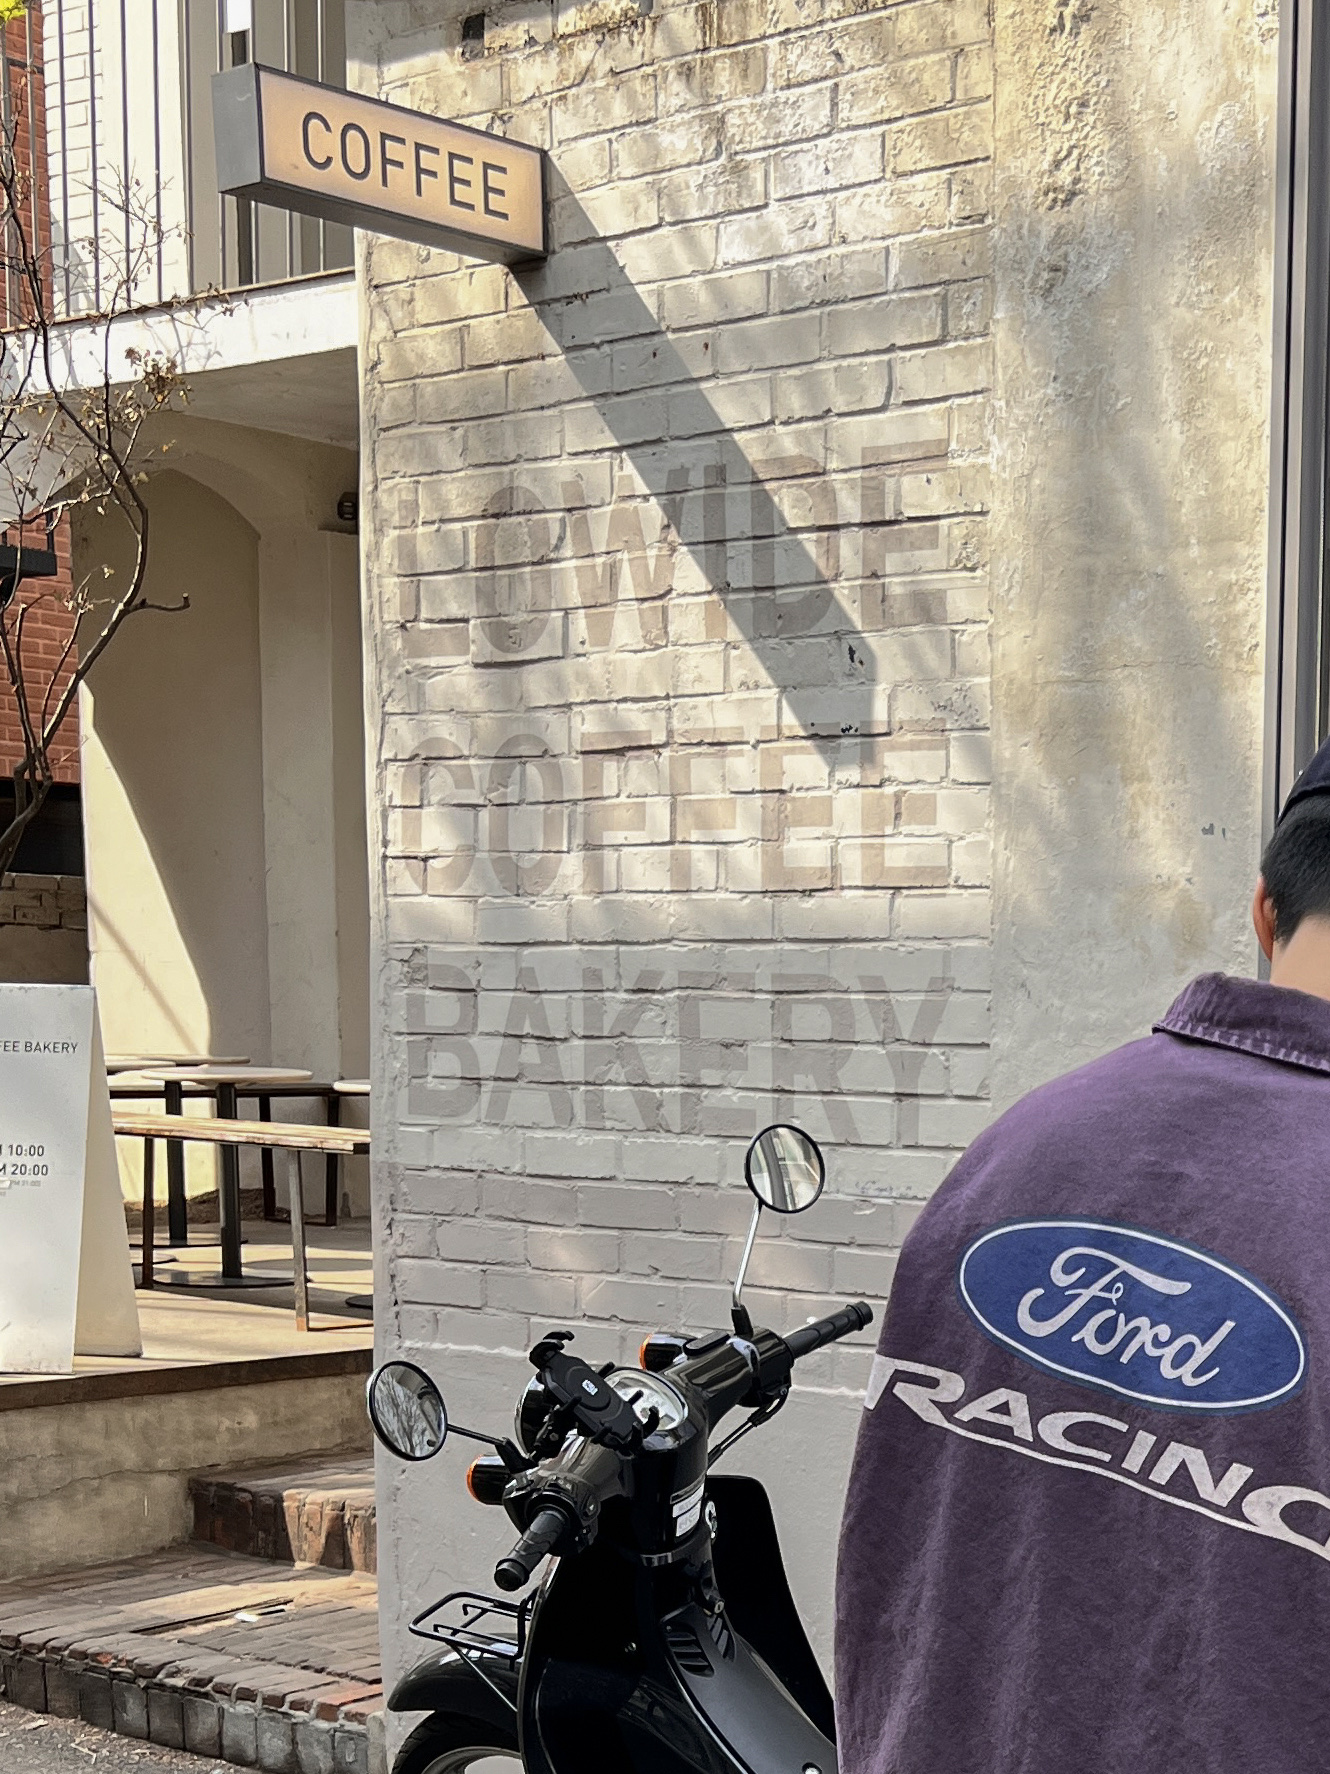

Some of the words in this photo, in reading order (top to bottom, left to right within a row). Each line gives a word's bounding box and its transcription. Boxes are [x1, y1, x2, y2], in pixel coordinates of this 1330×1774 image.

[302, 111, 509, 221] COFFEE
[397, 437, 948, 660] LOWIDE
[400, 718, 948, 898] COFFEE
[24, 1040, 79, 1054] BAKERY
[405, 962, 956, 1146] BAKERY
[8, 1143, 45, 1157] 10:00
[11, 1163, 49, 1176] 20:00
[1016, 1245, 1237, 1388] Ford
